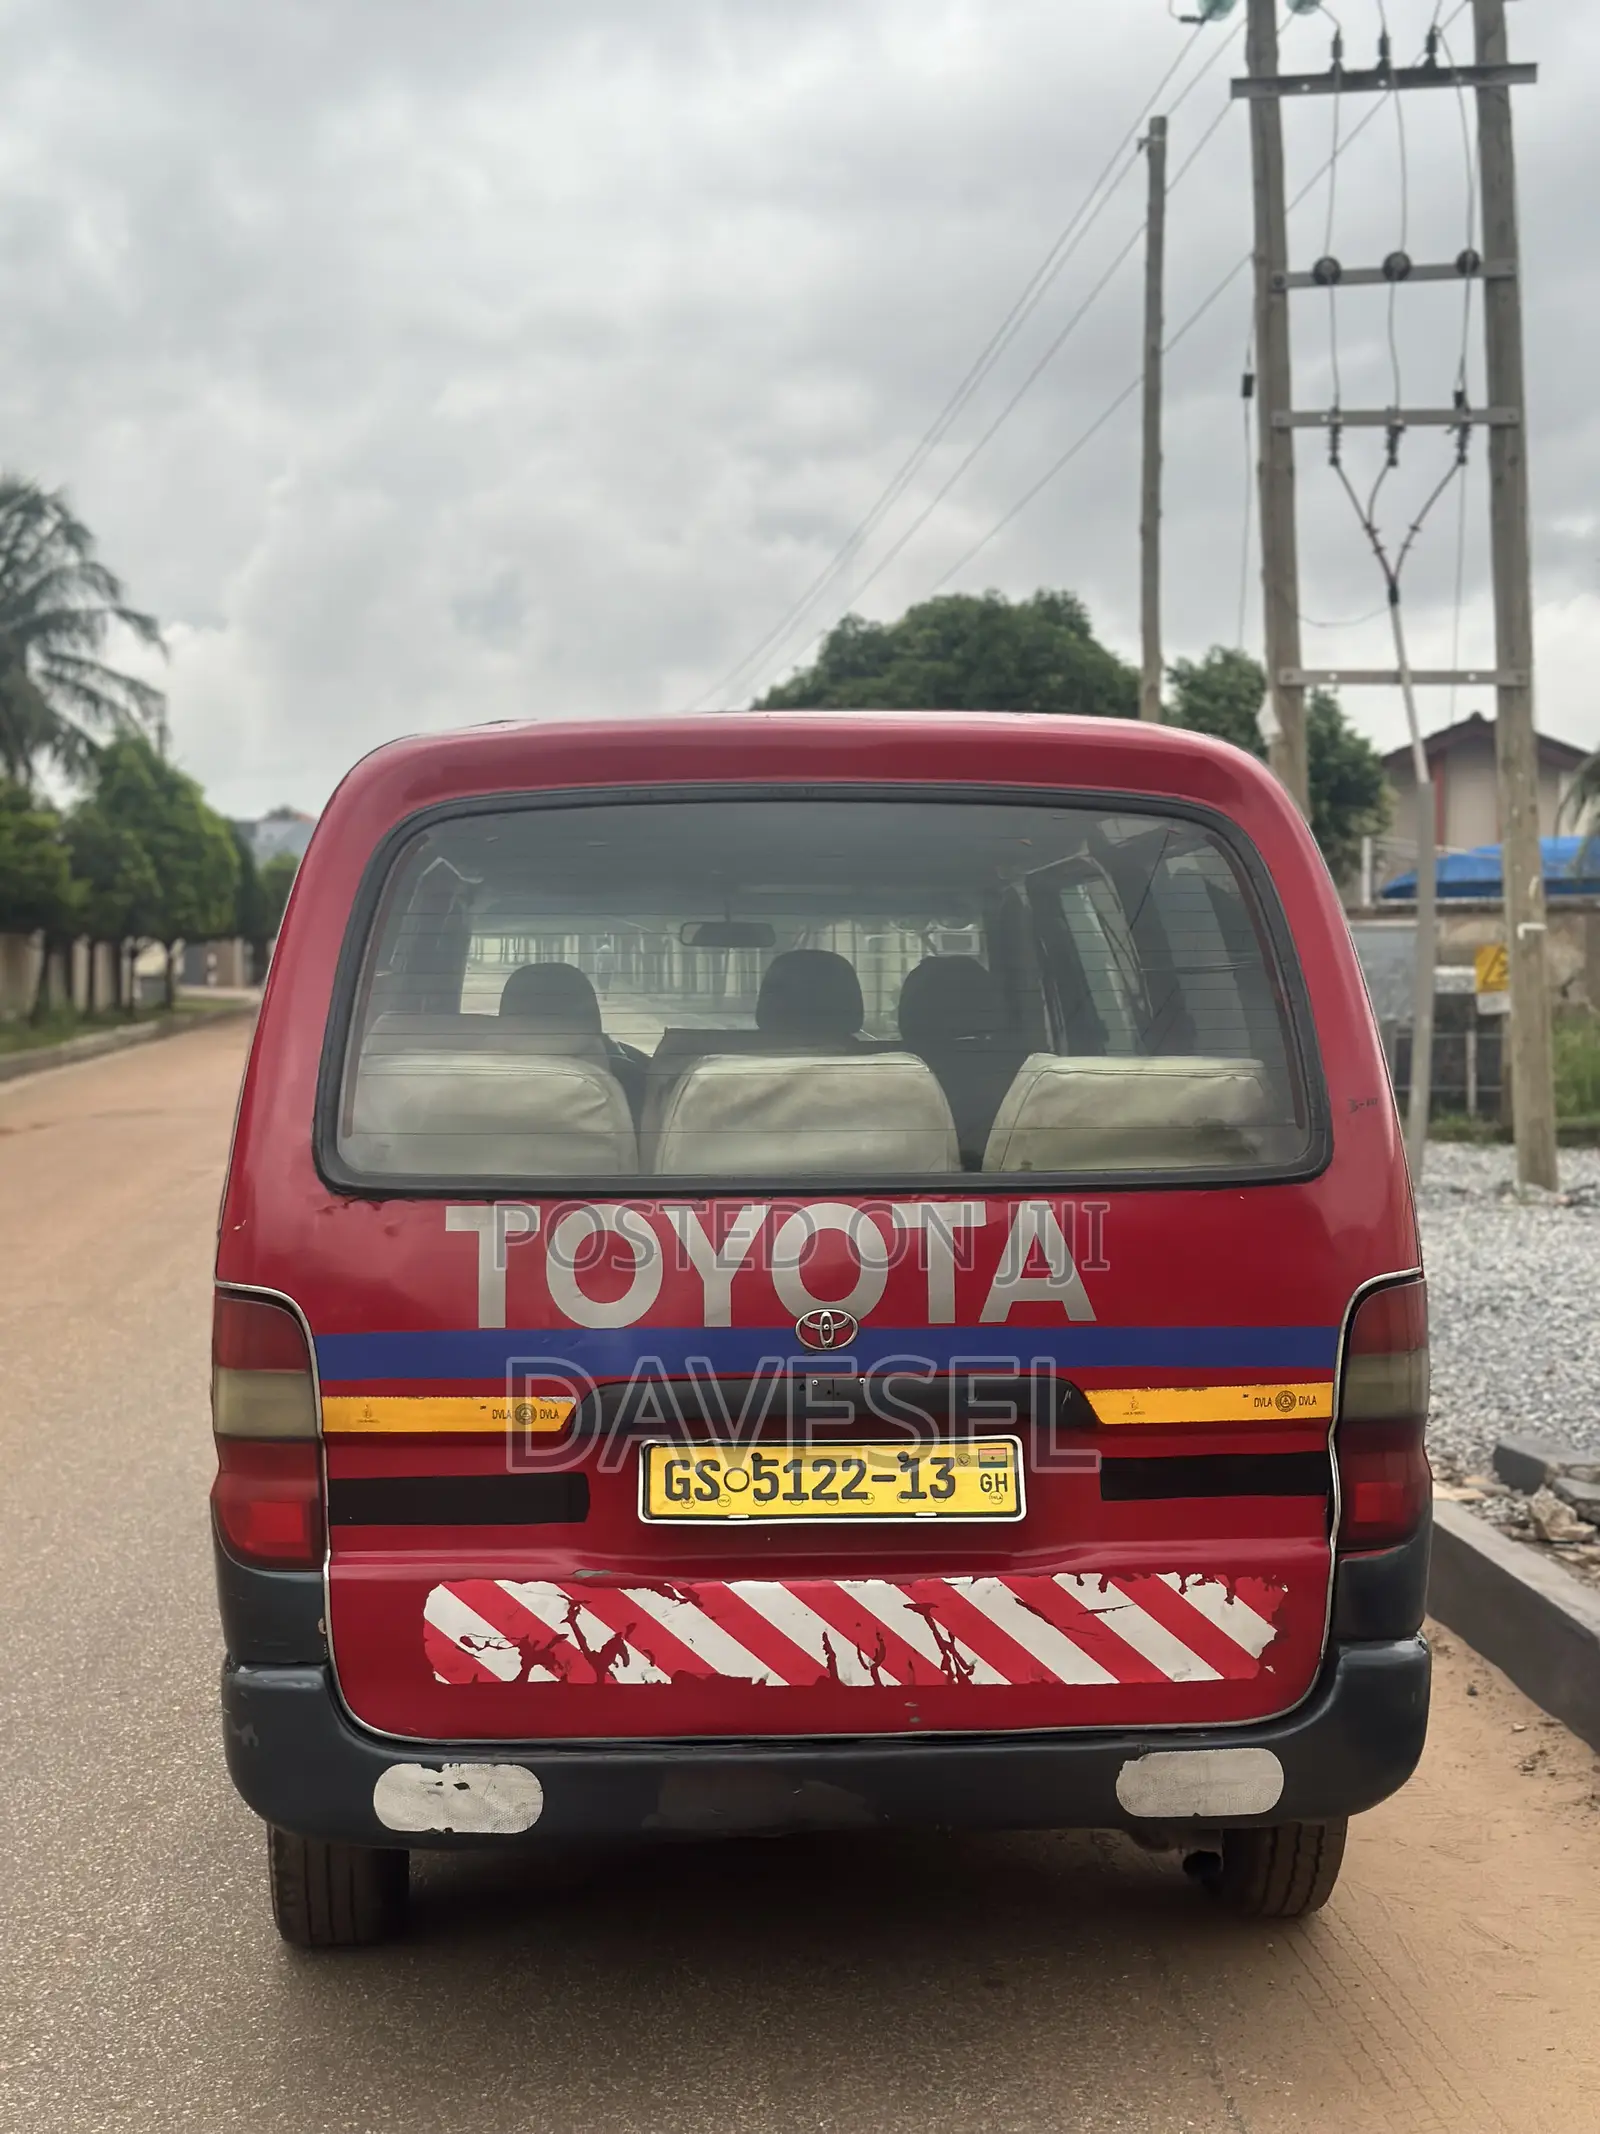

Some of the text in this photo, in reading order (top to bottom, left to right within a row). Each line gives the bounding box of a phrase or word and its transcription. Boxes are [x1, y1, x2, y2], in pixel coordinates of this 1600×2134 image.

[445, 1200, 1097, 1329] TOYOTA
[1254, 1397, 1272, 1407] DVLA
[1299, 1395, 1317, 1406] DVLA
[492, 1409, 511, 1419] DVLA
[540, 1408, 559, 1419] DVLA
[979, 1473, 1008, 1493] GH
